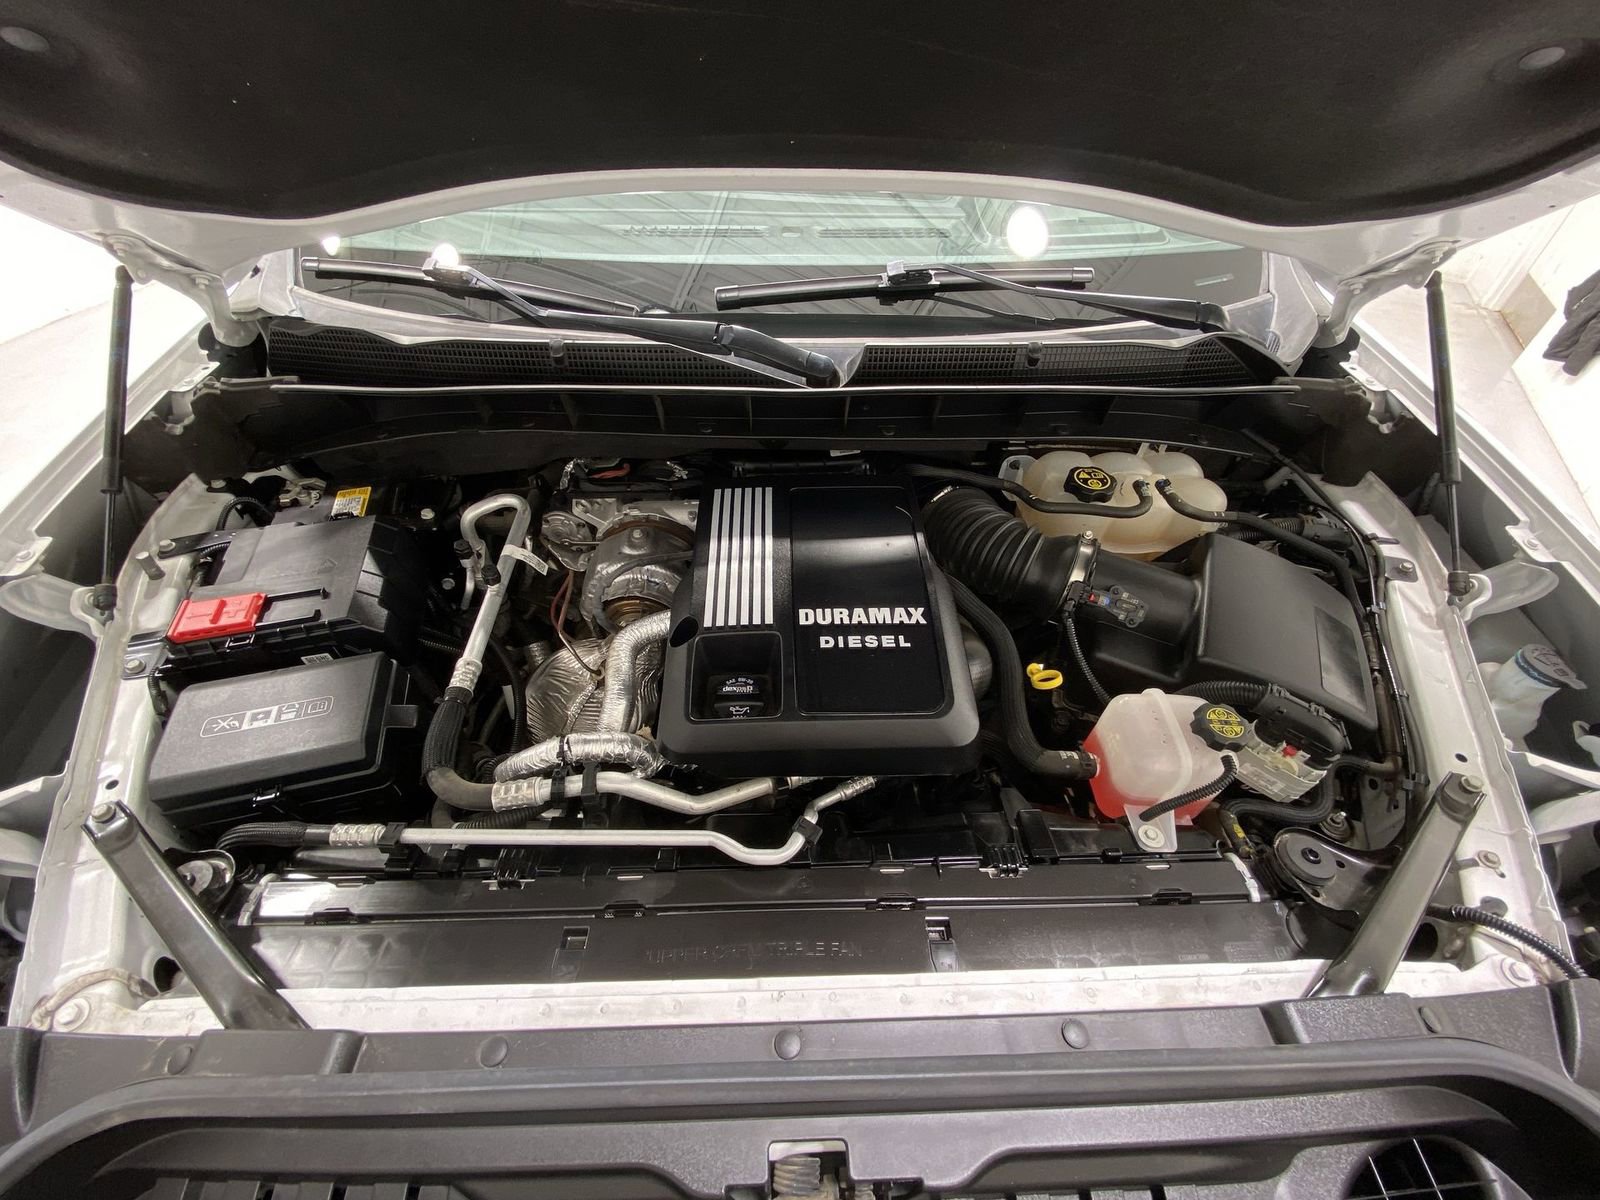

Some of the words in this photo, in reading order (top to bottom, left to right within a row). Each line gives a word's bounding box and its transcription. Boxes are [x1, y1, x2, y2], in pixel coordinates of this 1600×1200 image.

[798, 607, 927, 625] DURAMAX
[819, 635, 911, 648] DIESEL
[766, 942, 826, 957] TRIPLE
[830, 941, 863, 957] FAN
